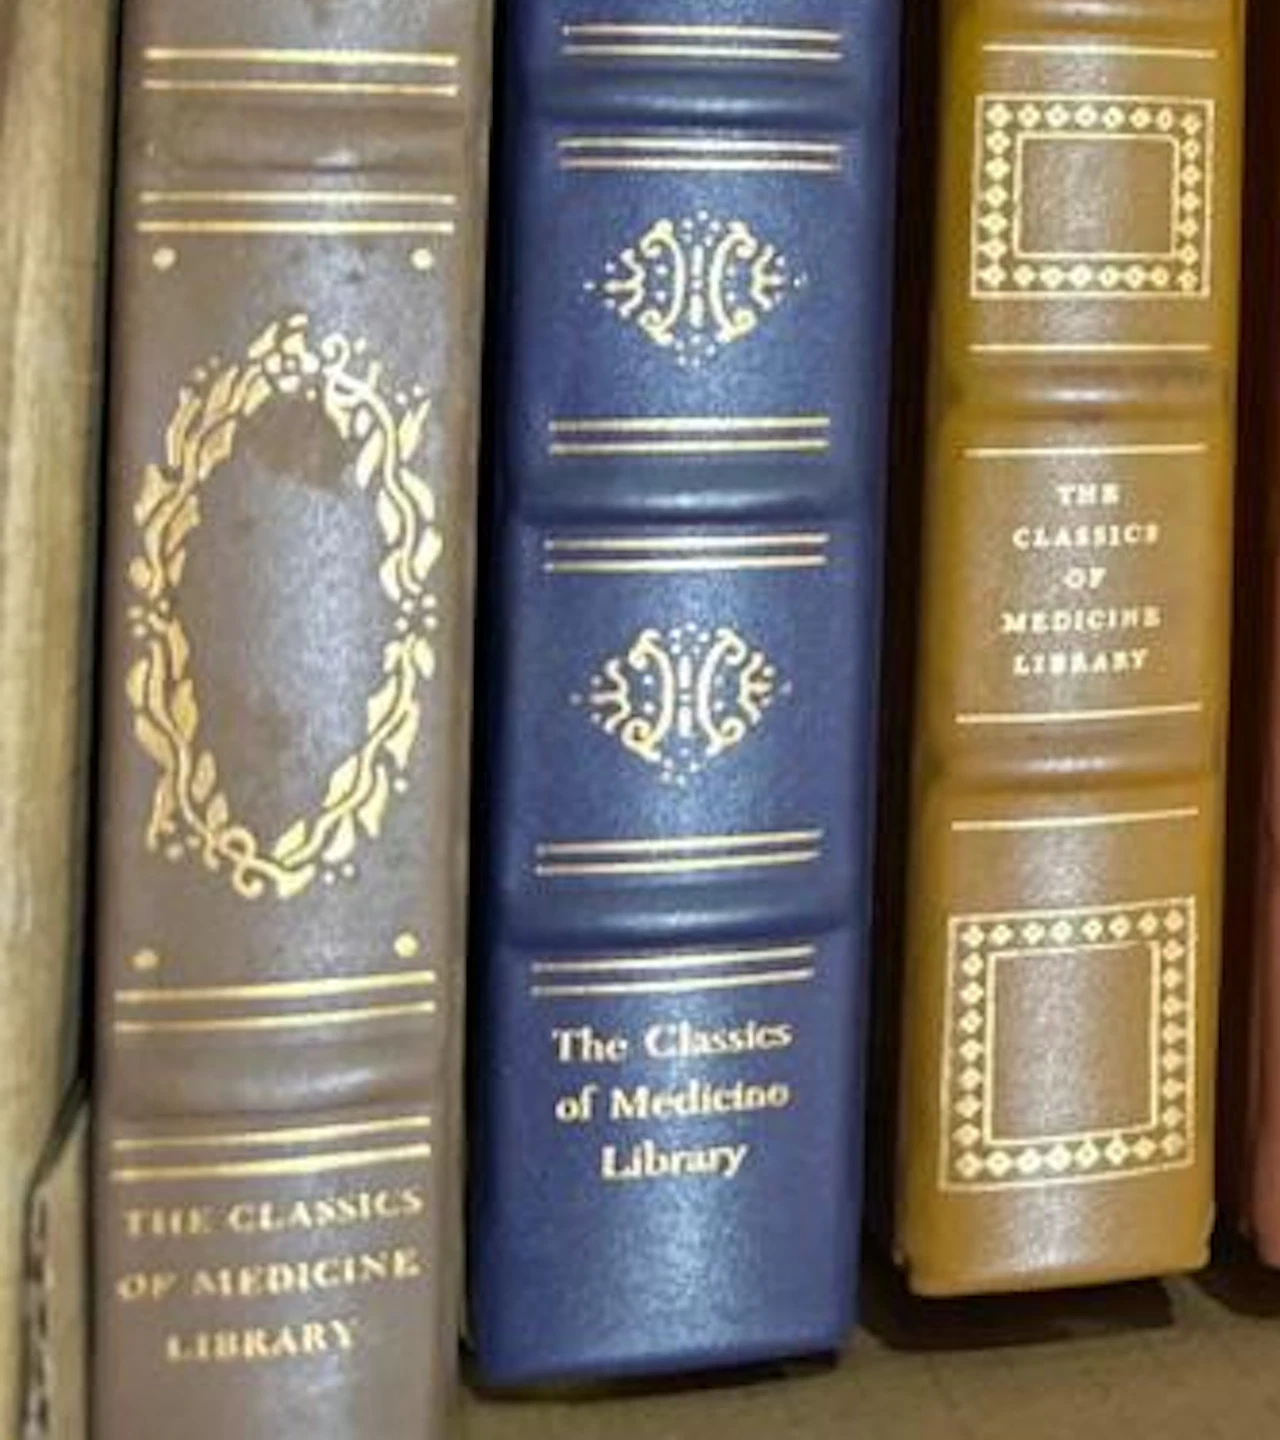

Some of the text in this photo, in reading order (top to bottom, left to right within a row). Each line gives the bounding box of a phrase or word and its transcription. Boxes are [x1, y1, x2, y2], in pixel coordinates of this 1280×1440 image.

[1056, 483, 1120, 506] THE
[1012, 523, 1159, 551] CLASSICS
[1064, 567, 1107, 590] OF
[1000, 606, 1161, 634] MEDICINE
[1013, 648, 1148, 676] LIBRARY
[552, 1020, 794, 1062] The Classics
[554, 1078, 790, 1122] of Medicine
[601, 1139, 747, 1180] Library
[124, 1187, 424, 1237] THE CLASSICS
[117, 1247, 422, 1300] OF MEDICINE
[165, 1317, 358, 1360] LIBRARY
